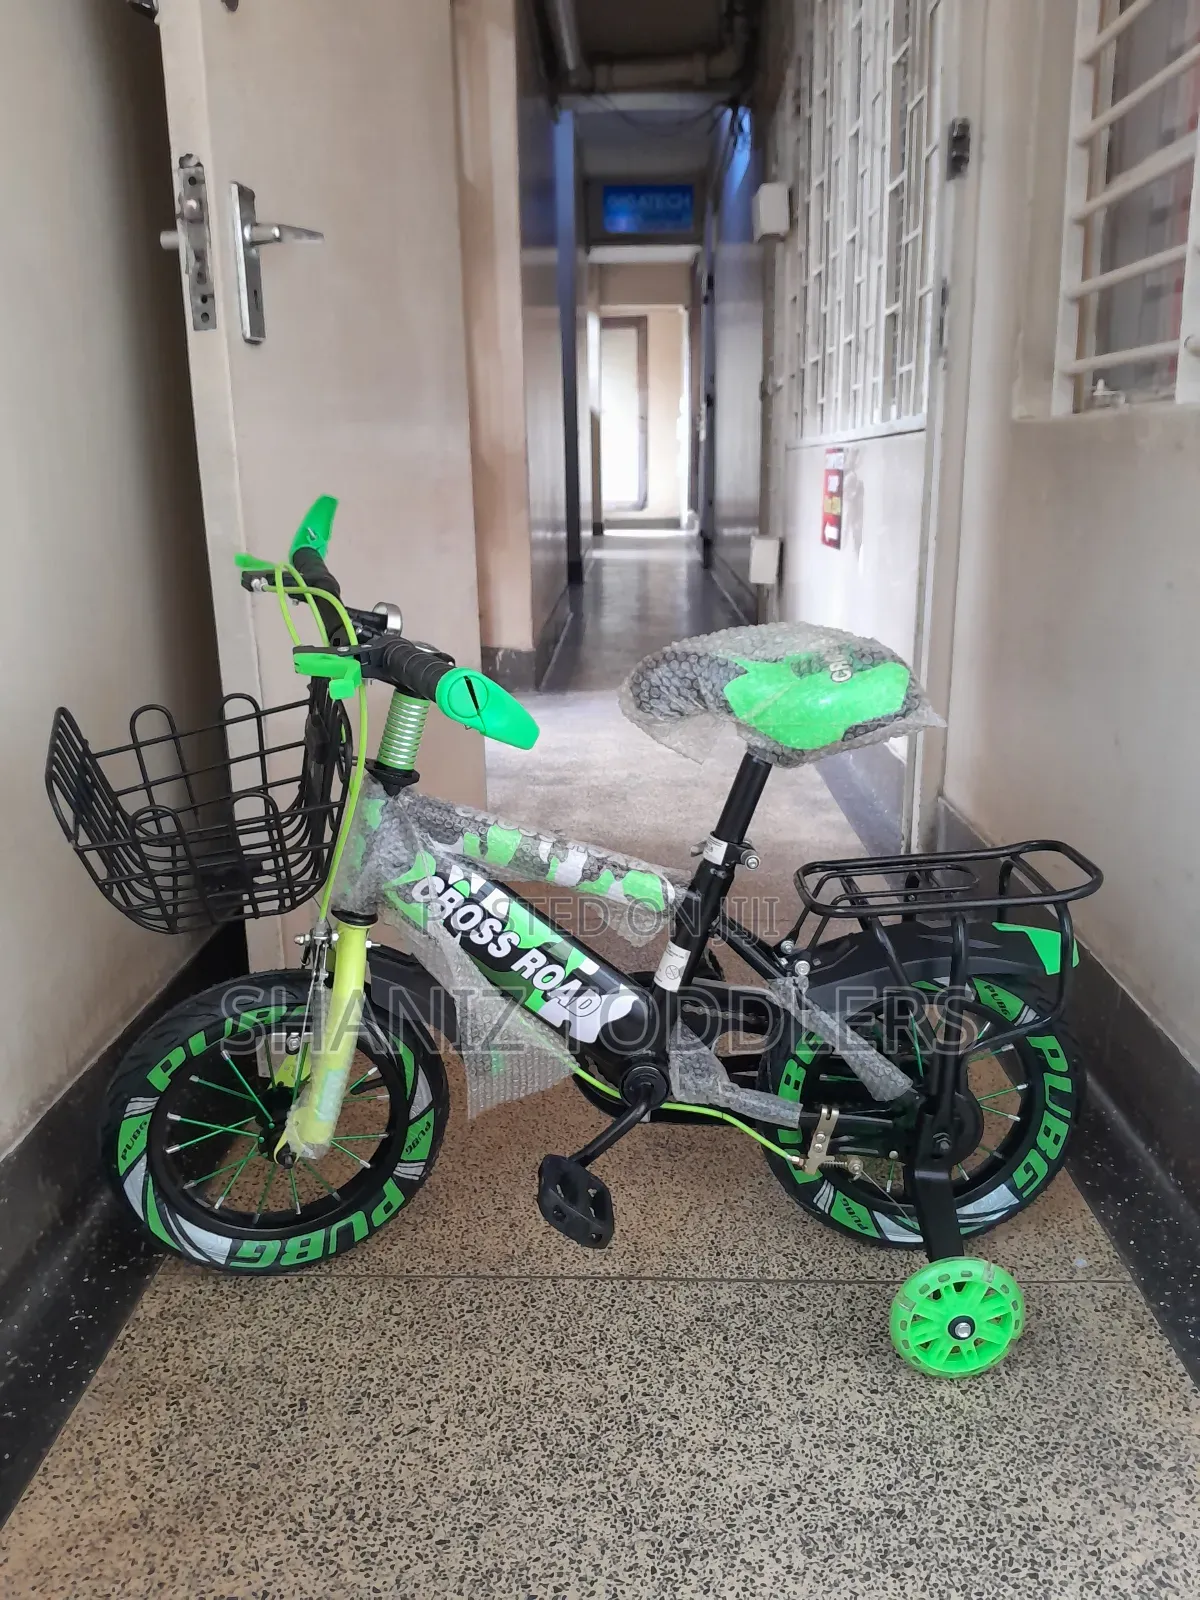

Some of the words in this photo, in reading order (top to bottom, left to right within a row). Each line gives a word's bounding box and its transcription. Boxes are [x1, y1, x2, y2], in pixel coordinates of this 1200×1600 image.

[411, 875, 520, 958] CROSS
[511, 948, 602, 1018] ROAD
[983, 984, 1013, 1017] PUBG
[405, 1119, 432, 1156] PUBG
[1026, 1035, 1072, 1199] PUBG
[229, 1176, 406, 1269] PUBG
[840, 1197, 869, 1231] PUBG
